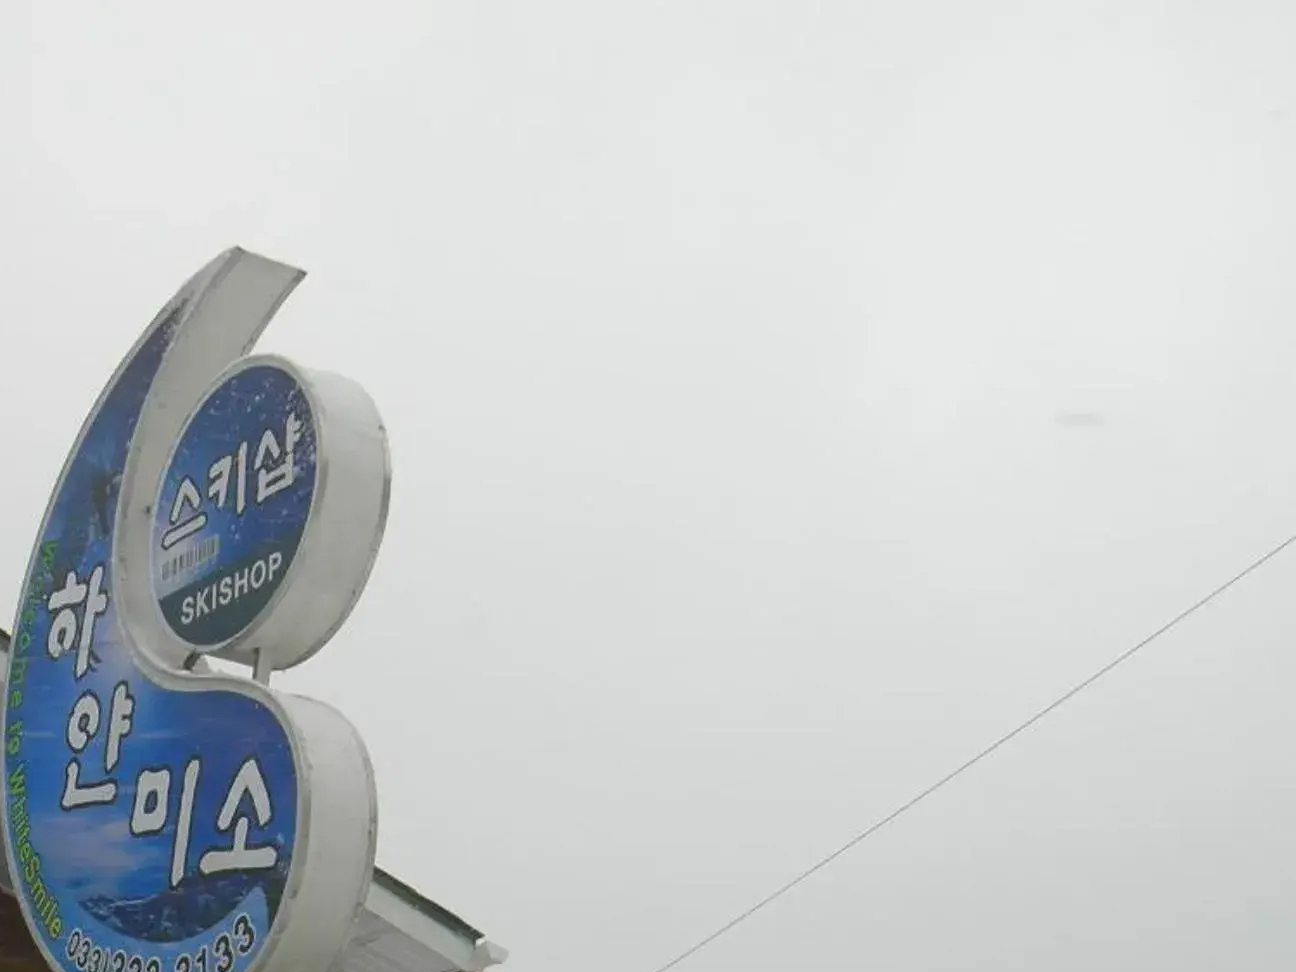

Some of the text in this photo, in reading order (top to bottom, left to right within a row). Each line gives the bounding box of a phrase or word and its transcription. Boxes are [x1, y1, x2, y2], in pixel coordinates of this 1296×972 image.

[162, 412, 303, 550] 스키샵
[180, 552, 283, 626] SKISHOP
[6, 719, 23, 756] to
